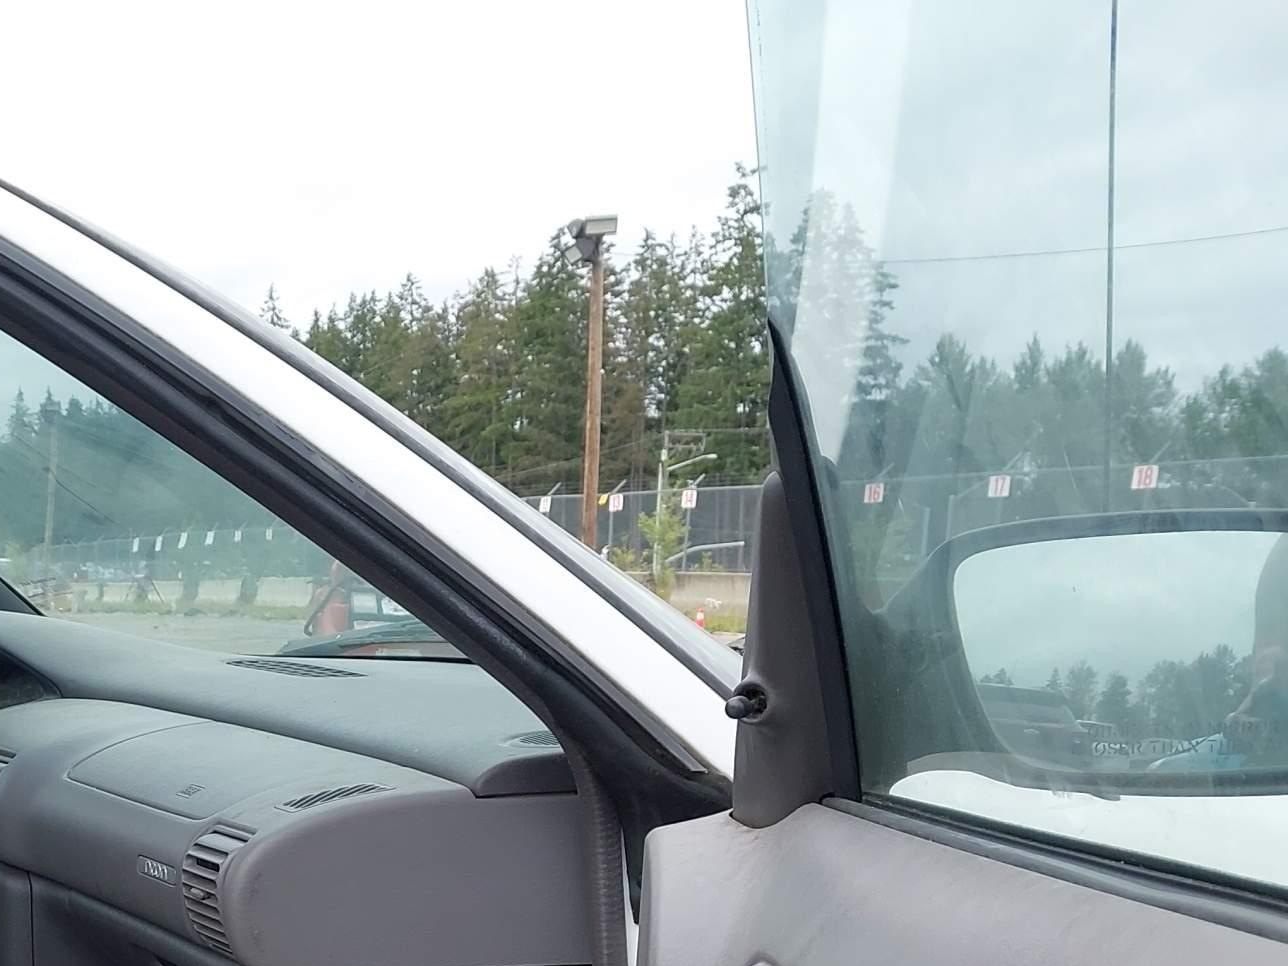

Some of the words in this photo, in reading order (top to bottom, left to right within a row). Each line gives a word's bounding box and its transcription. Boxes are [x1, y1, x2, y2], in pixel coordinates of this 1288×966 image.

[992, 476, 1006, 495] 17
[1136, 467, 1153, 487] 18
[867, 483, 881, 502] 16
